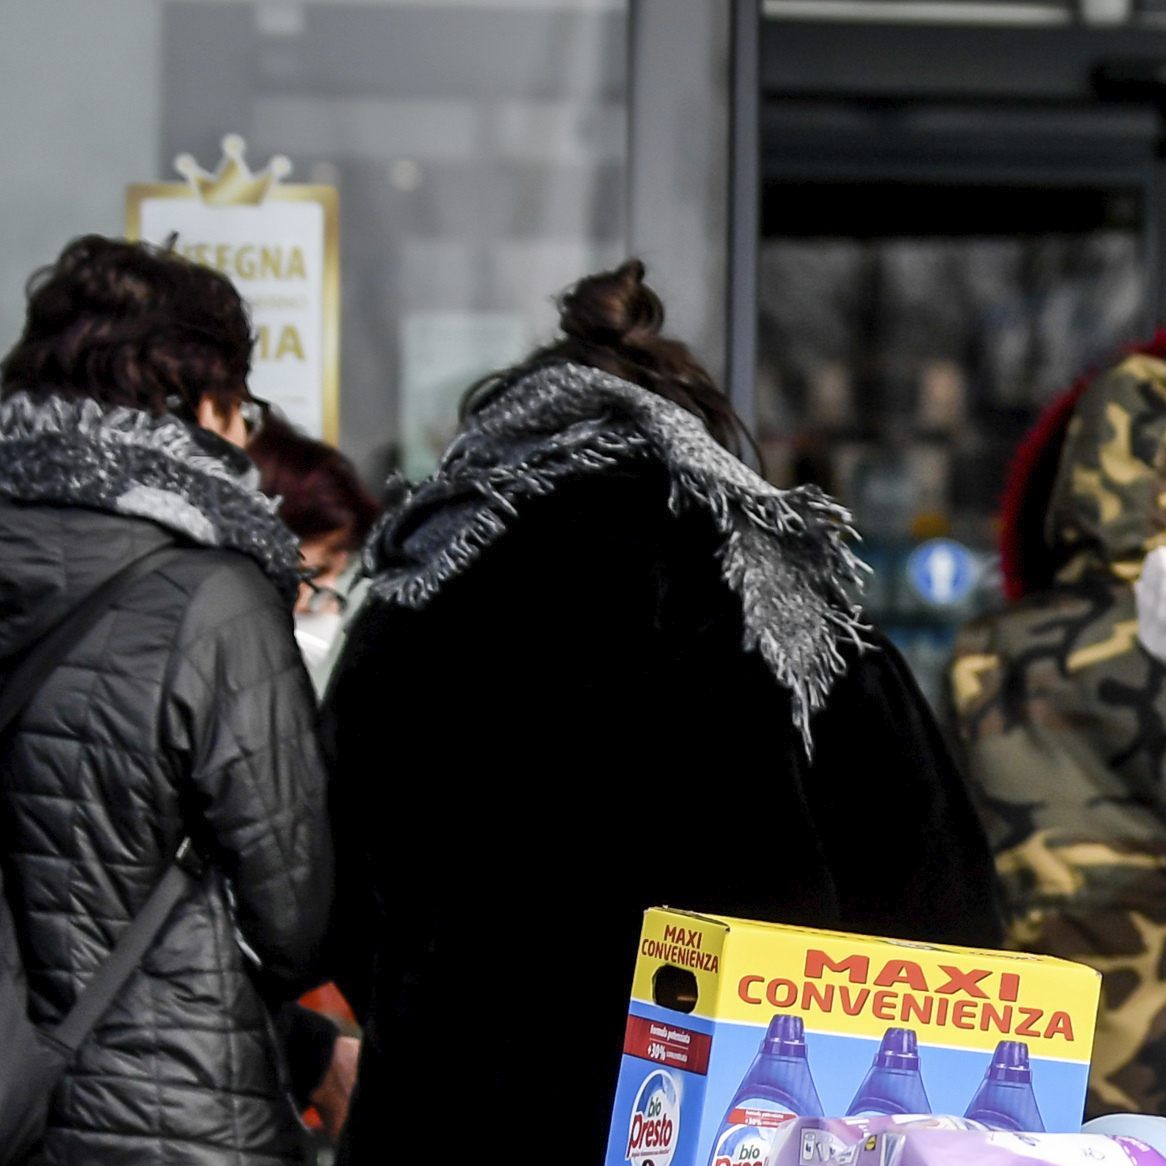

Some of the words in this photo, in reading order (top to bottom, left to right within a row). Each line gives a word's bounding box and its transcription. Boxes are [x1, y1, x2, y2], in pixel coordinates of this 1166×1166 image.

[664, 924, 703, 949] MAXI
[641, 938, 719, 974] CONVENIENZA
[803, 948, 1021, 1002] MAXI
[737, 974, 1076, 1042] CONVENIENZA
[648, 1096, 662, 1118] bio
[739, 1143, 761, 1160] bio
